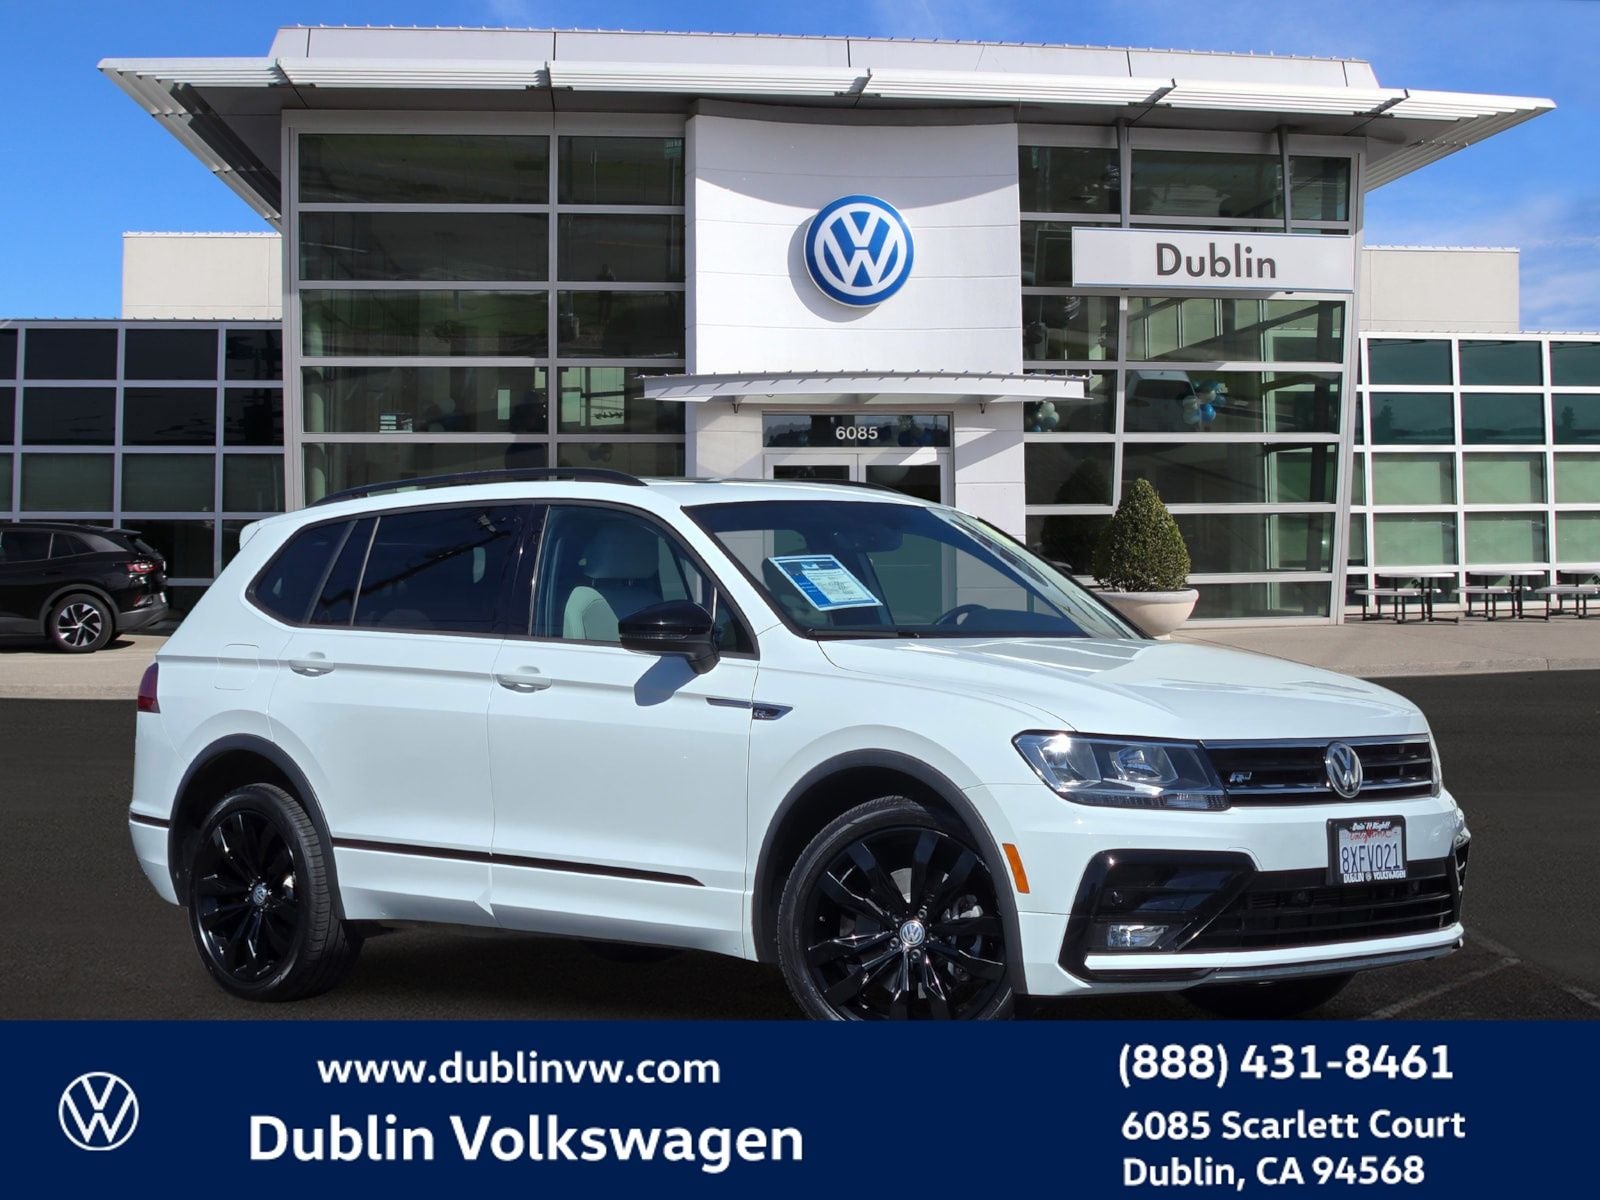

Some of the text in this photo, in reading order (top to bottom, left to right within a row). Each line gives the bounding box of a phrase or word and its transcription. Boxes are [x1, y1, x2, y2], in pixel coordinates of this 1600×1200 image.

[814, 203, 906, 296] VW
[1156, 242, 1276, 278] Dublin
[835, 426, 879, 440] 6085
[1341, 843, 1401, 874] 8XFV021
